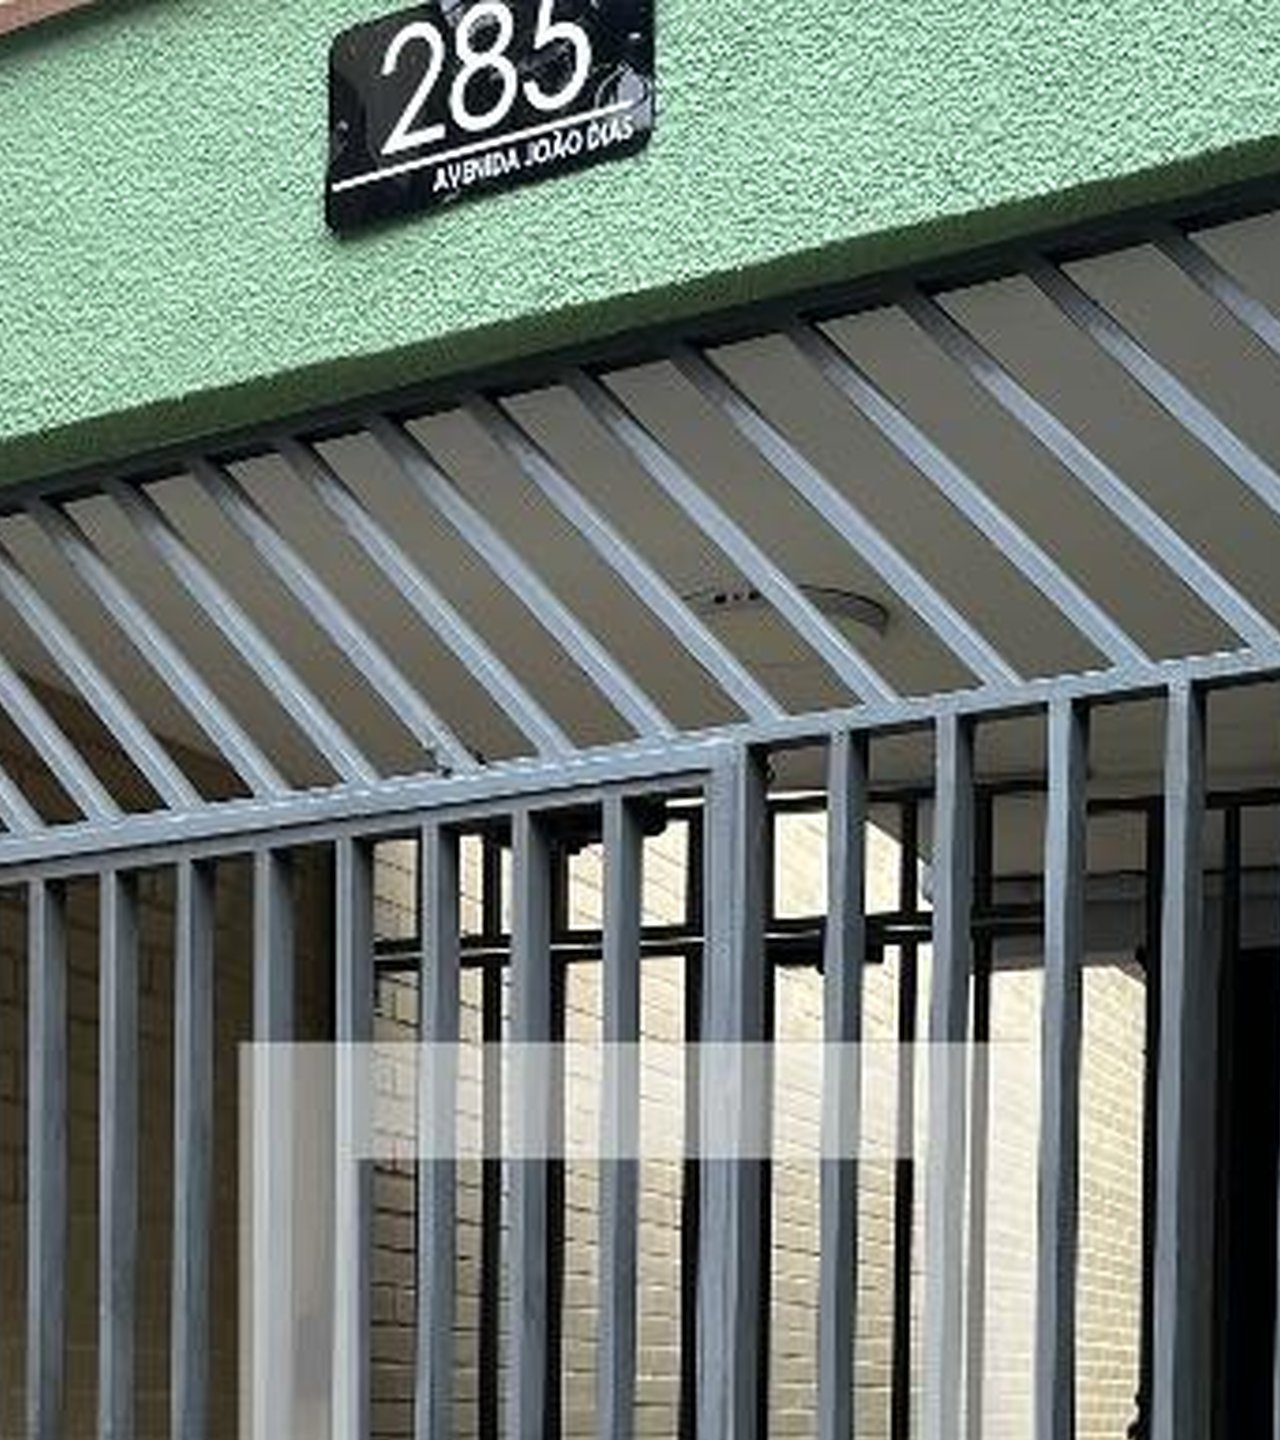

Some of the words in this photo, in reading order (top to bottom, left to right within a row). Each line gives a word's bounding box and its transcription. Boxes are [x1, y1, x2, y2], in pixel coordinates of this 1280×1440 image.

[379, 0, 592, 155] 285
[432, 149, 520, 193] AVENIDA
[586, 115, 634, 151] DIAS
